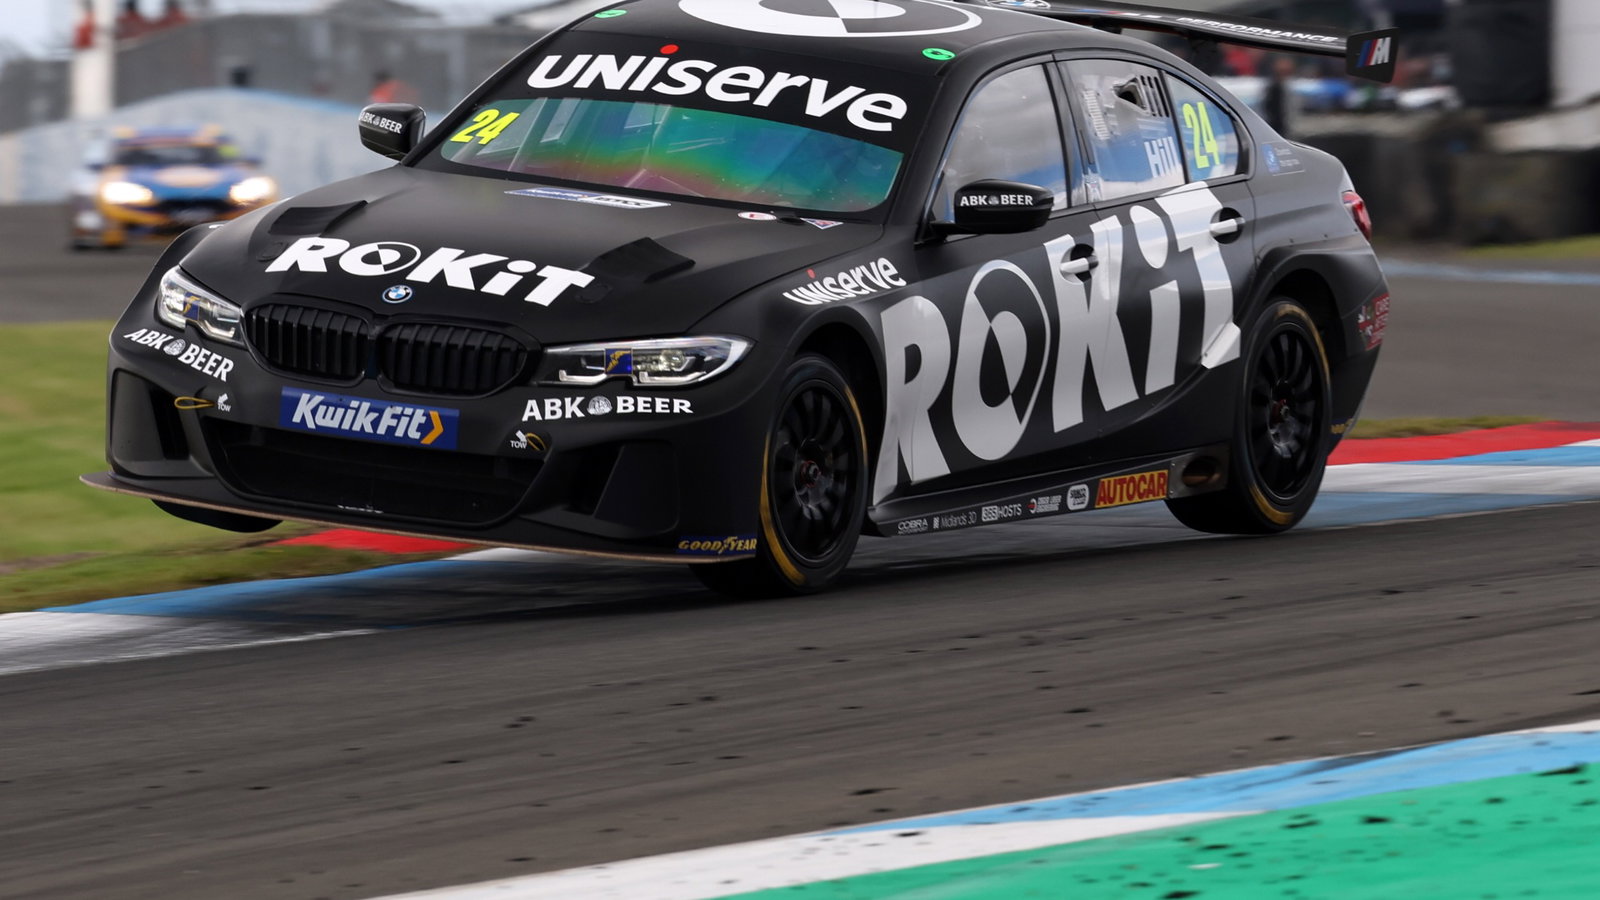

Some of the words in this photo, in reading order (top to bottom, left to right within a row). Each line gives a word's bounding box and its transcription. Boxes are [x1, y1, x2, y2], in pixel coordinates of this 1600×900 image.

[1176, 17, 1340, 43] PERFORMANCE
[379, 117, 403, 134] BEER
[451, 108, 520, 144] 24
[1182, 101, 1220, 169] 24
[1143, 136, 1180, 178] Hill
[960, 195, 988, 207] ABK
[1000, 194, 1034, 206] BEER
[123, 327, 172, 351] ABK
[179, 343, 235, 382] BEER
[521, 395, 586, 422] ABK
[616, 396, 694, 415] BEER
[510, 439, 527, 449] TOW
[1096, 472, 1167, 506] AUTOCAR
[897, 518, 929, 530] COBRA
